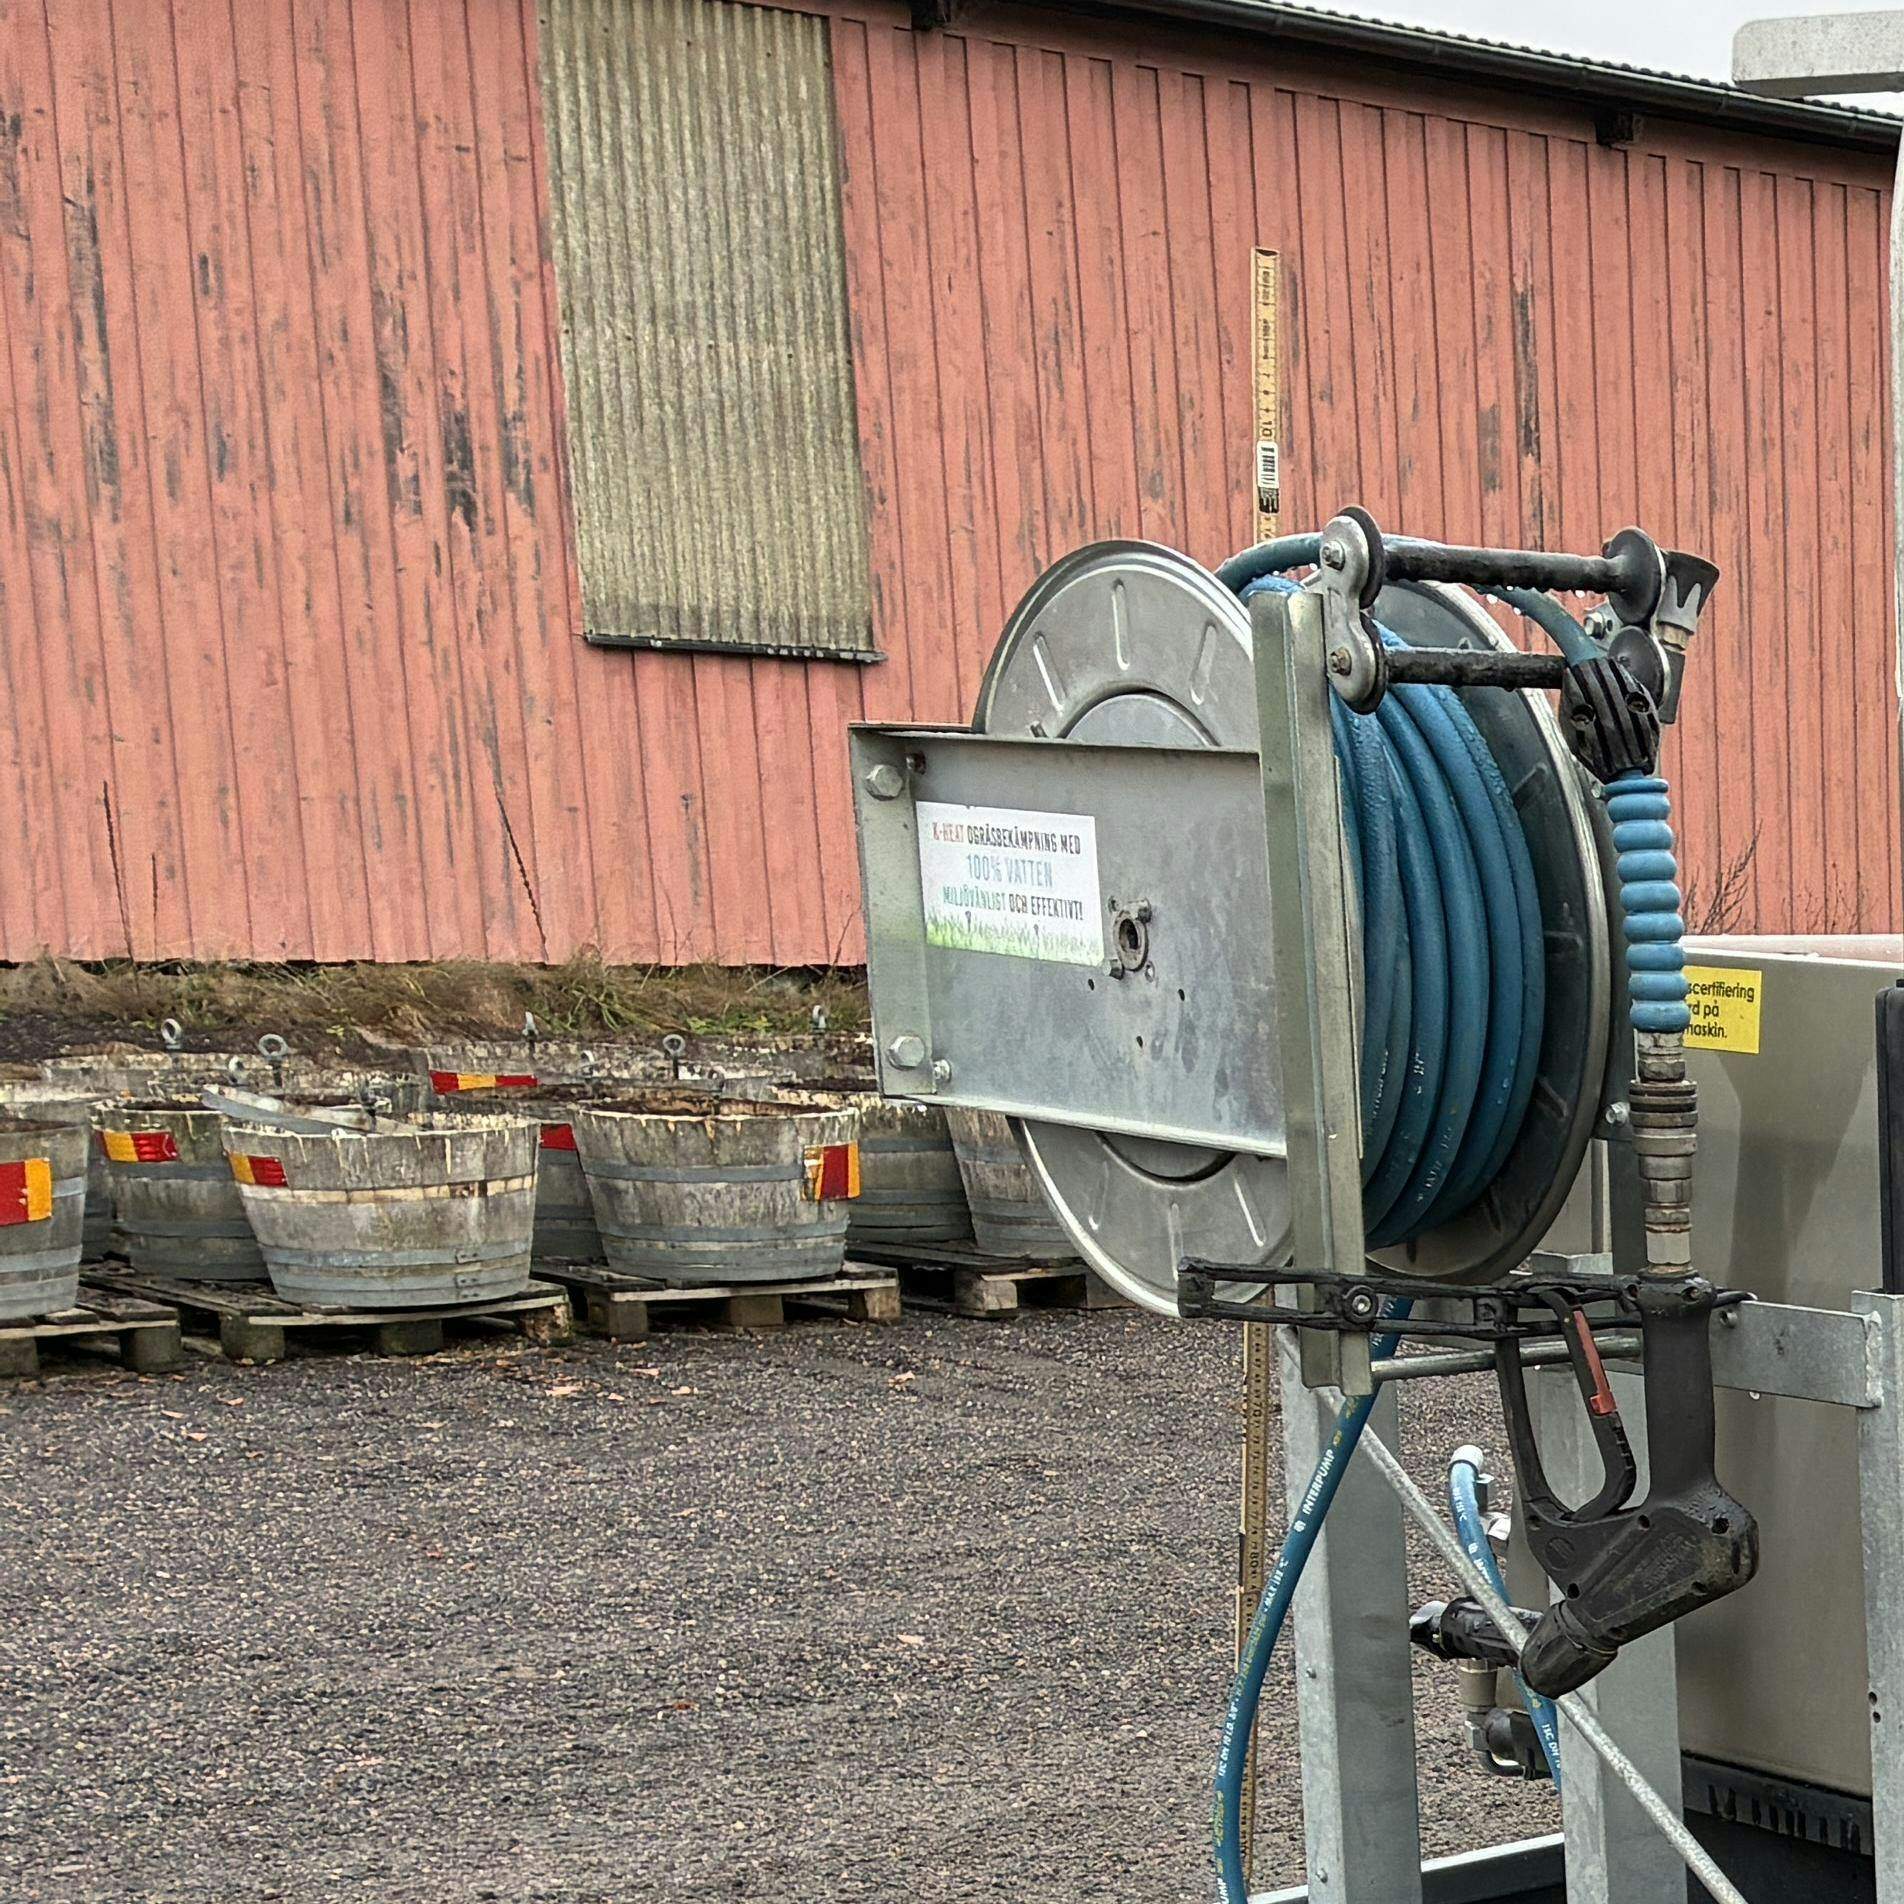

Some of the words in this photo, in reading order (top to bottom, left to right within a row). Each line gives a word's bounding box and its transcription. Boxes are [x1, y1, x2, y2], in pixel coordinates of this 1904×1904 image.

[932, 822, 964, 842] K-HEAT
[967, 823, 1057, 853] OGRÄSBEKÄMPNING
[1060, 833, 1081, 855] MED
[967, 854, 1001, 882] 100%
[1005, 856, 1053, 888] VATTEN
[943, 884, 1005, 911] MILJÖVÄNLIGT
[1009, 893, 1027, 913] OCH
[1031, 895, 1083, 920] EFFEKTIVT!
[1686, 981, 1755, 1003] scertifiering
[1703, 1000, 1719, 1019] på
[1303, 1448, 1335, 1515] INTERPUMP
